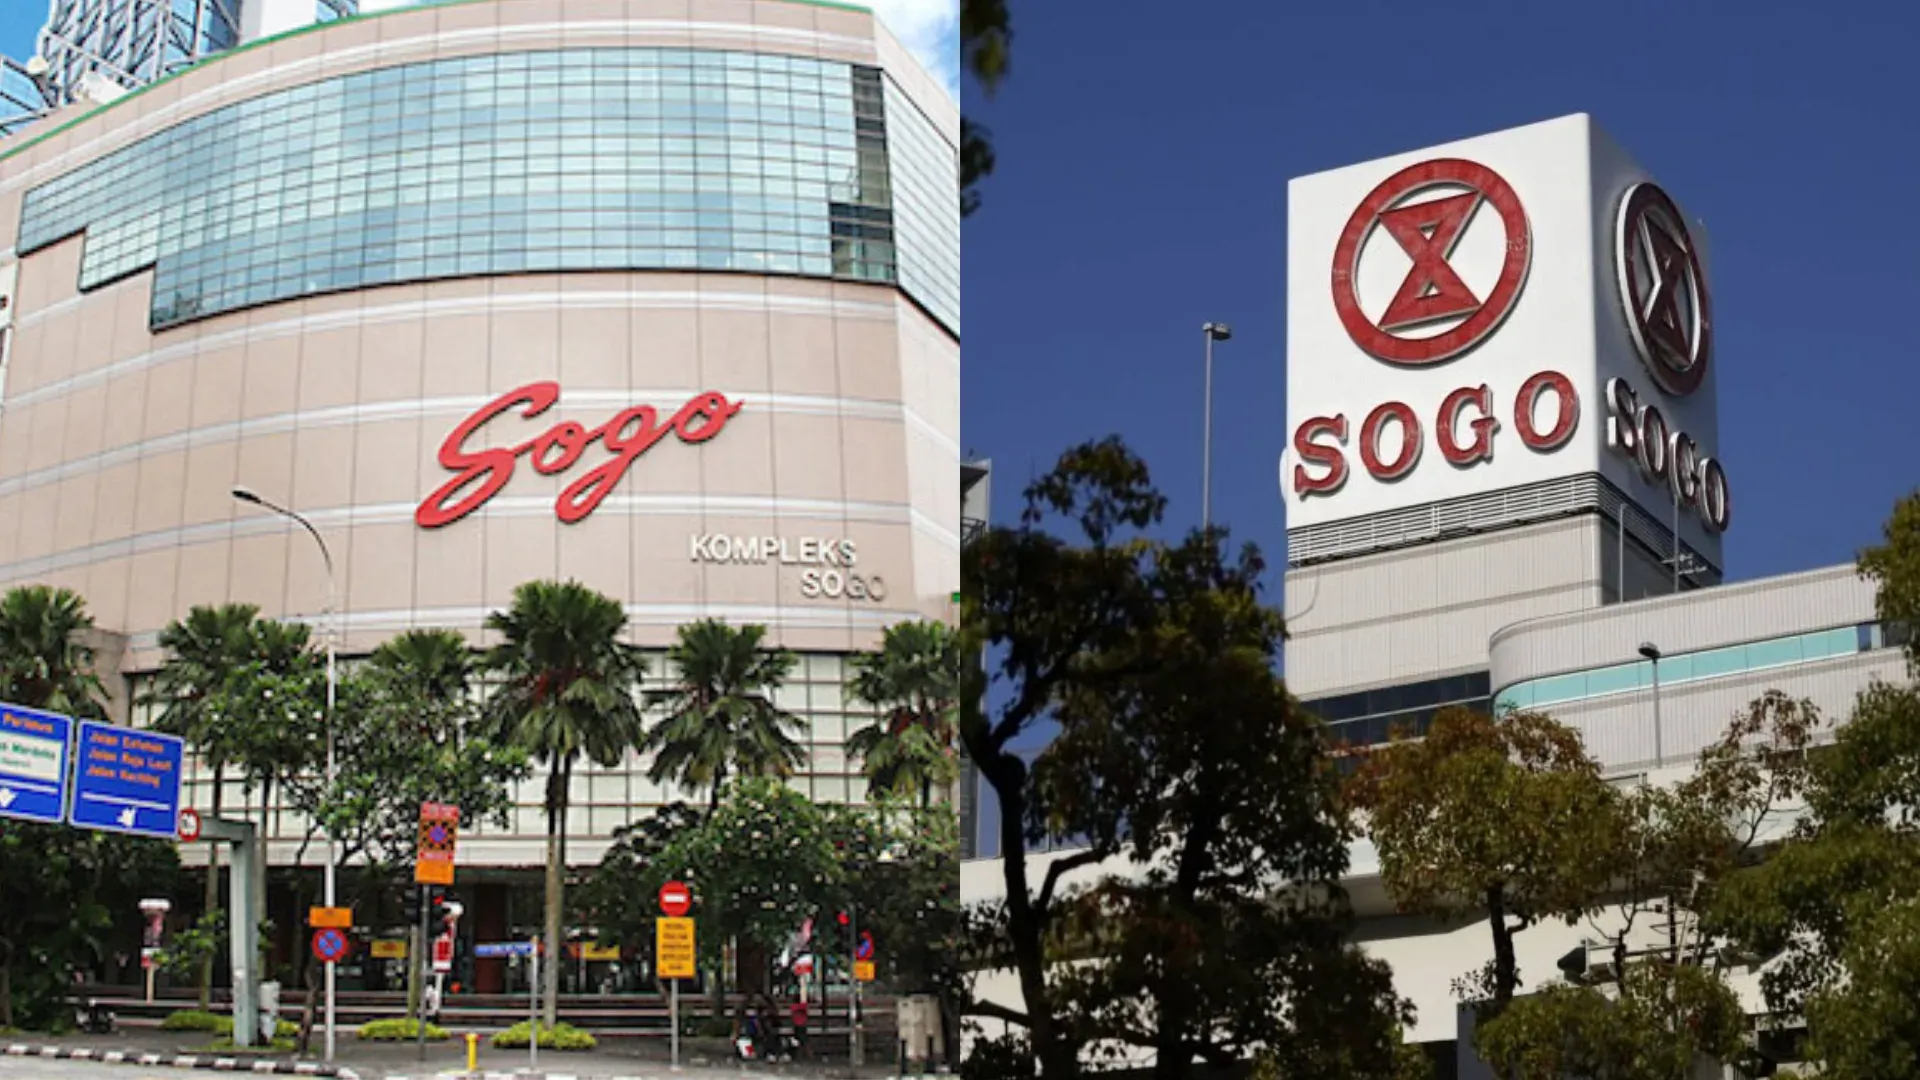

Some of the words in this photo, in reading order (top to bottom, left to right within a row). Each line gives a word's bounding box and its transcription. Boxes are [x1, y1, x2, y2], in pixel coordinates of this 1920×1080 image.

[415, 380, 744, 527] Sogo
[1293, 370, 1582, 501] SOGO
[1605, 376, 1729, 532] SOGO
[690, 534, 857, 566] KOMPLEKS
[802, 568, 887, 601] SOGO
